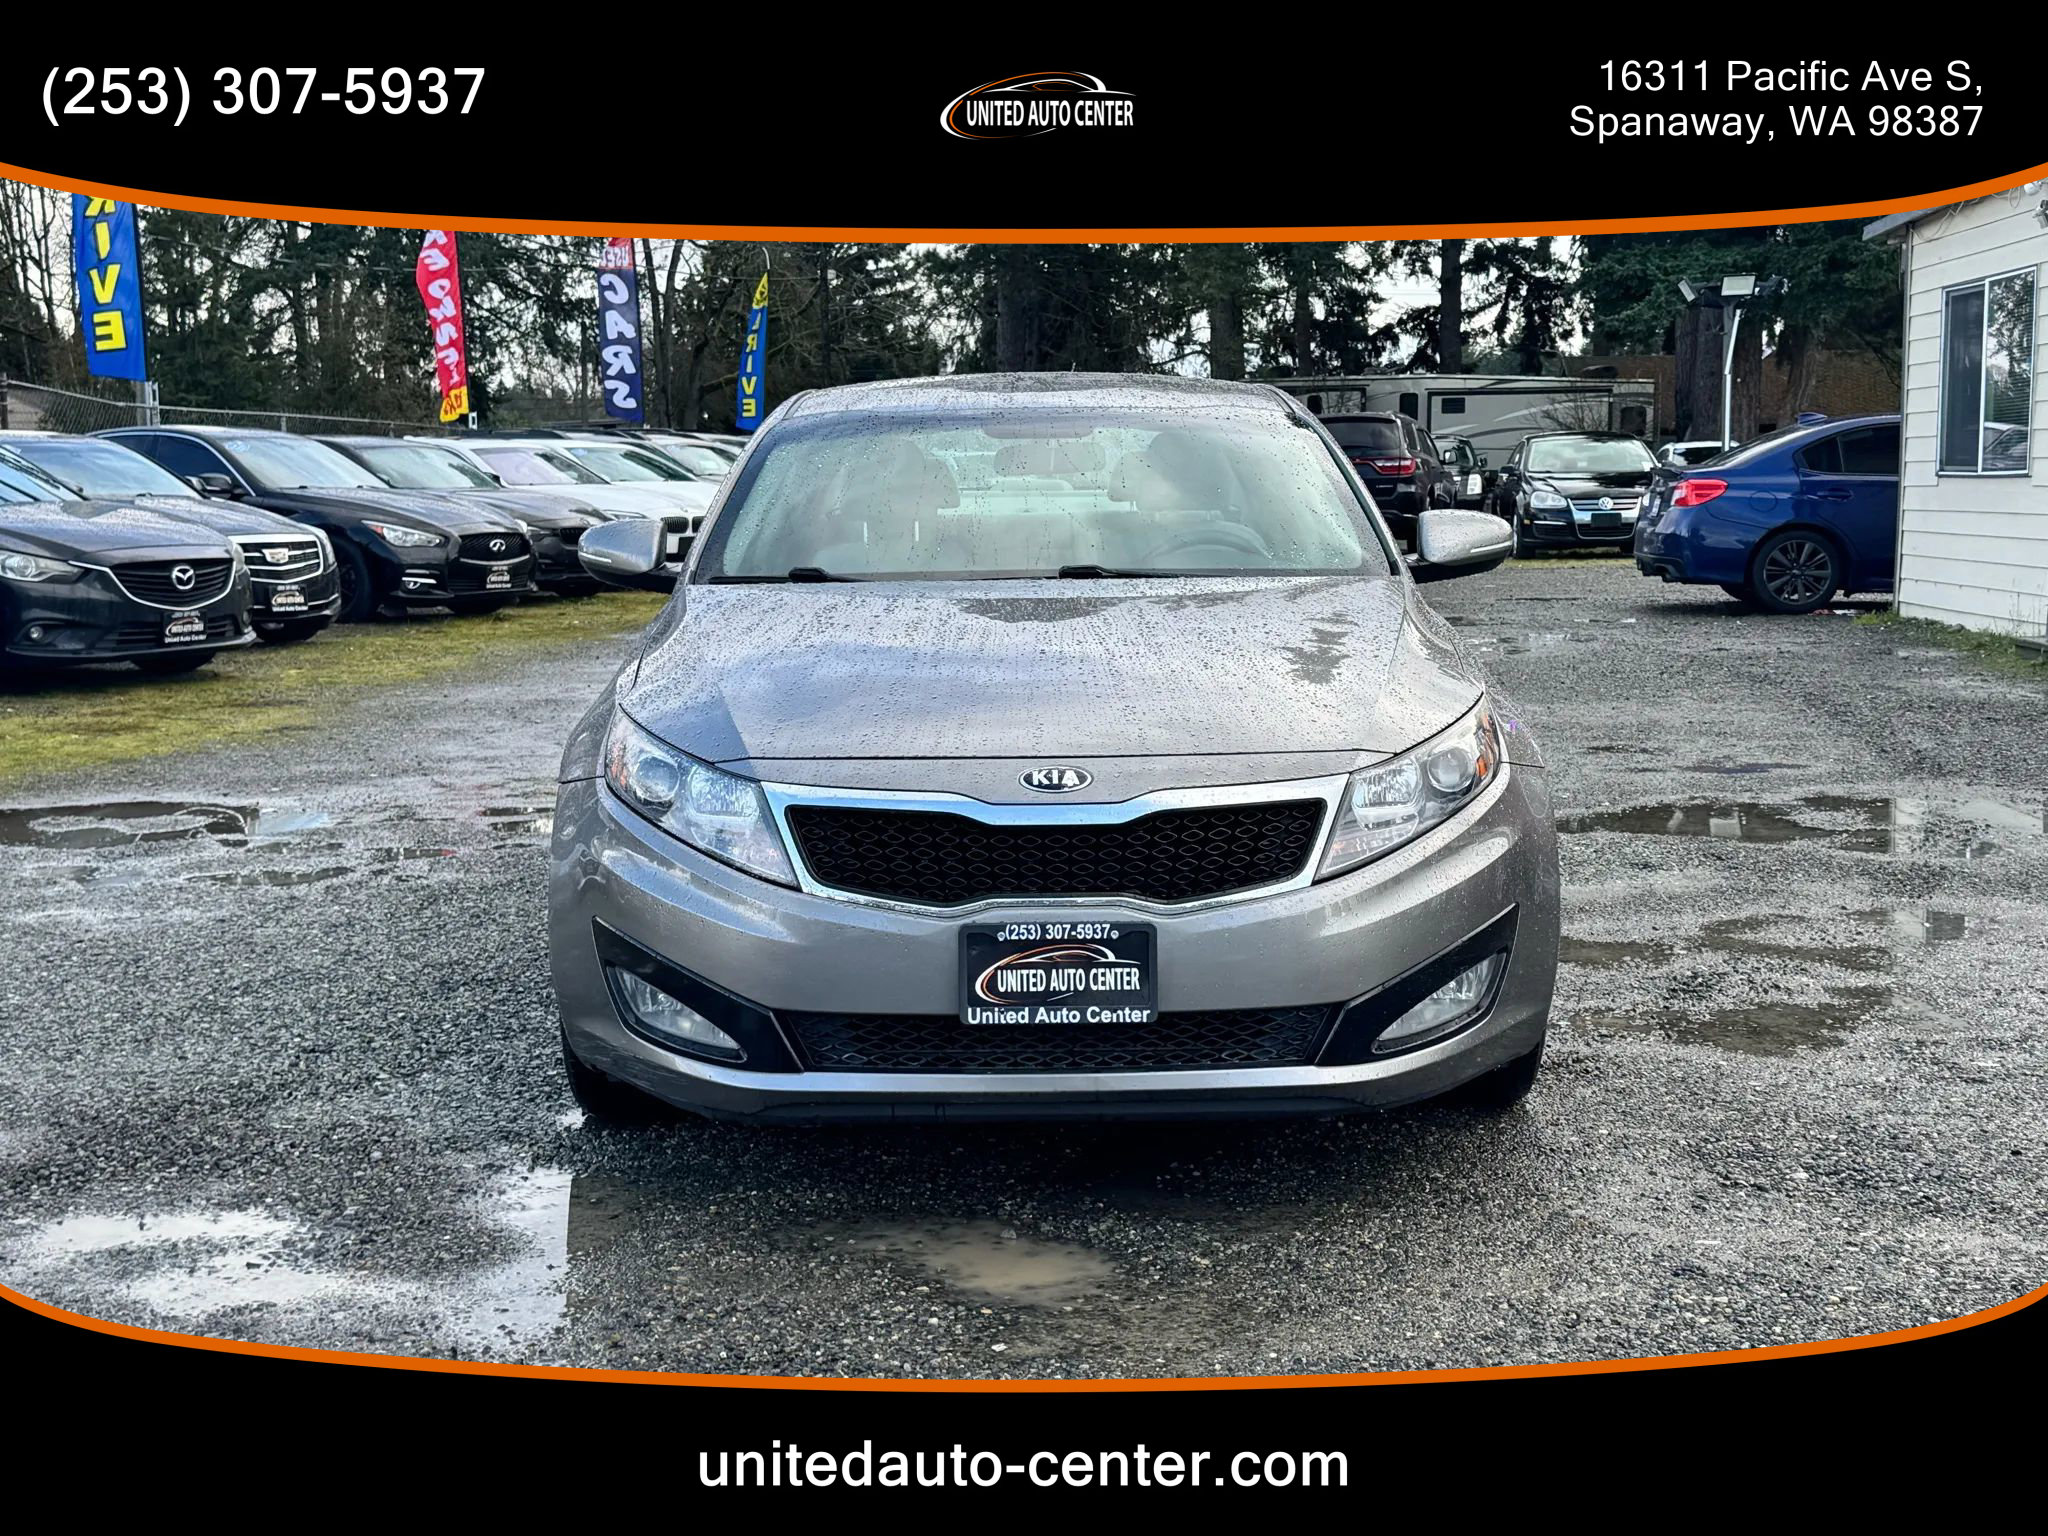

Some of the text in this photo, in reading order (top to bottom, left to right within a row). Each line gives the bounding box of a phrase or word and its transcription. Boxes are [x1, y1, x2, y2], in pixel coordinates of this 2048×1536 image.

[1032, 769, 1080, 786] KIA
[1006, 924, 1110, 940] (253) 307-5937
[997, 967, 1140, 992] UNITED AUTO CENTER
[967, 1006, 1150, 1024] United Auto Center
